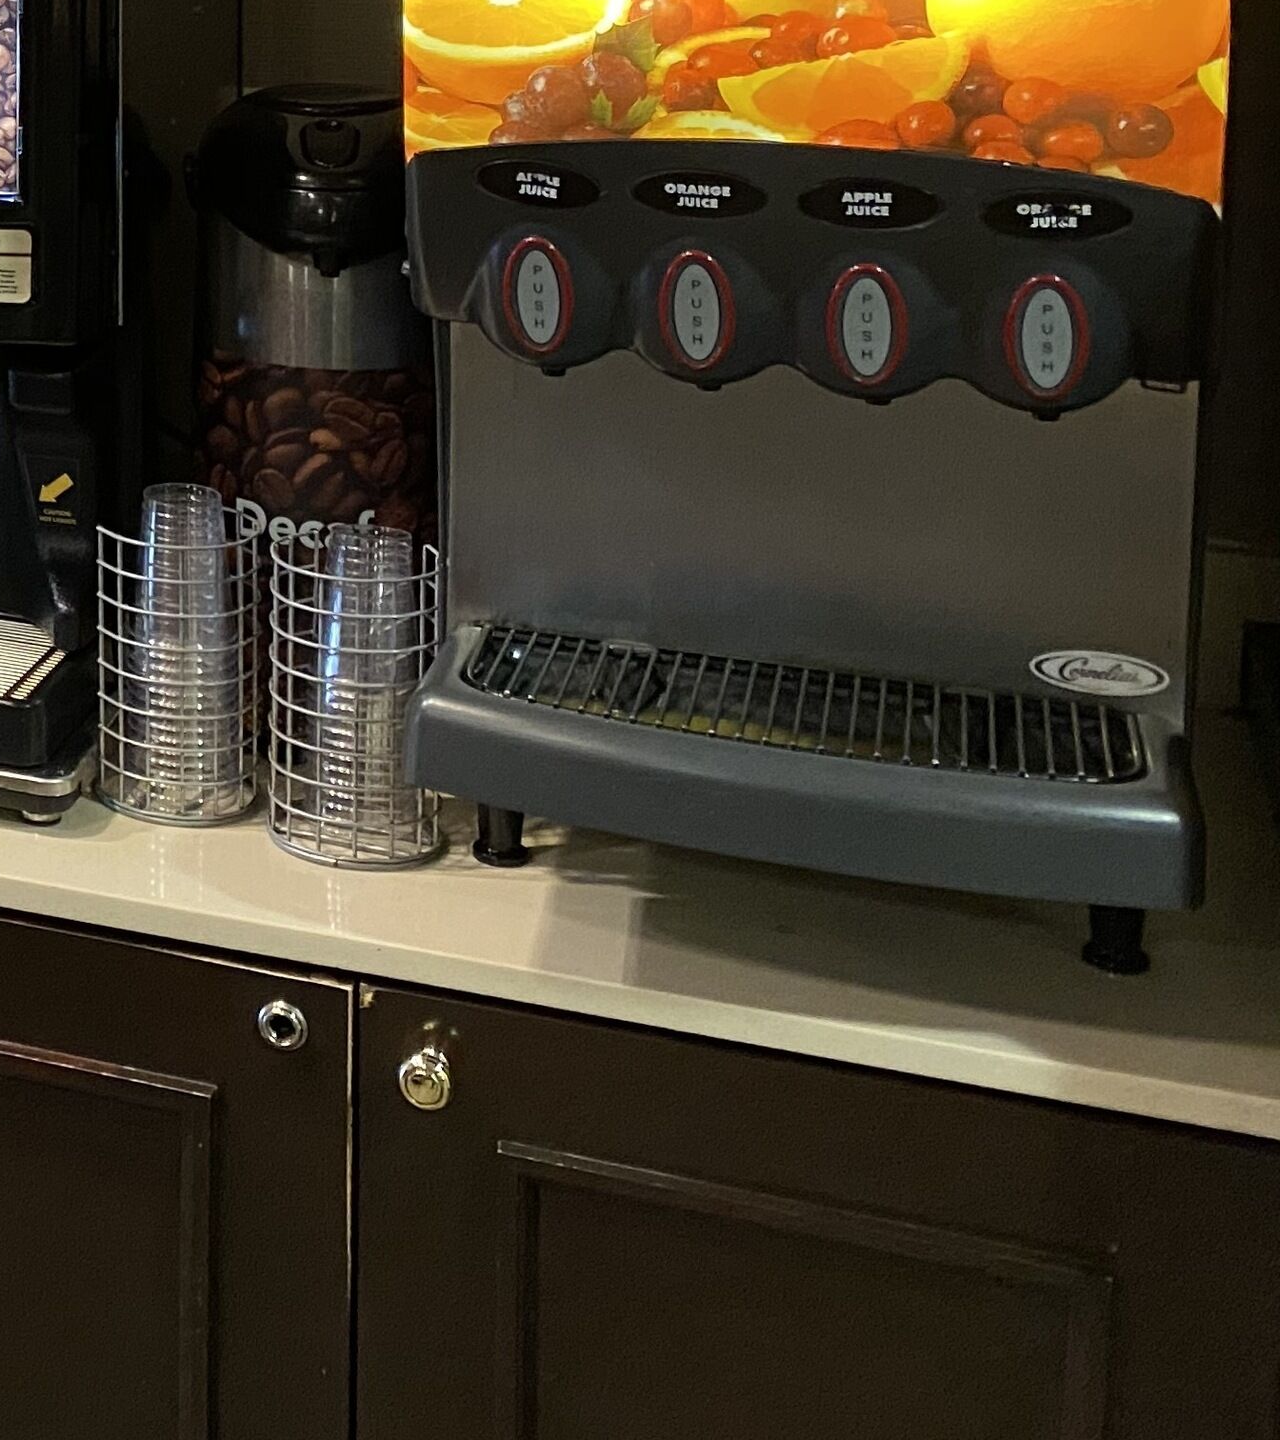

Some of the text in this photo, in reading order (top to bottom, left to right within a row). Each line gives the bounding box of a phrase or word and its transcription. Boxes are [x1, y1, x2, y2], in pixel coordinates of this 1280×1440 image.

[518, 184, 558, 199] JUICE
[664, 183, 731, 197] ORANGE
[841, 191, 892, 204] APPLE
[677, 197, 719, 209] JUICE
[845, 205, 890, 216] JUICE
[1016, 203, 1092, 216] ORGE
[532, 265, 545, 329] PUSH
[690, 279, 703, 345] PUSH
[861, 293, 873, 360] PUSH
[1042, 303, 1054, 373] PUSH
[236, 497, 375, 549] Decf
